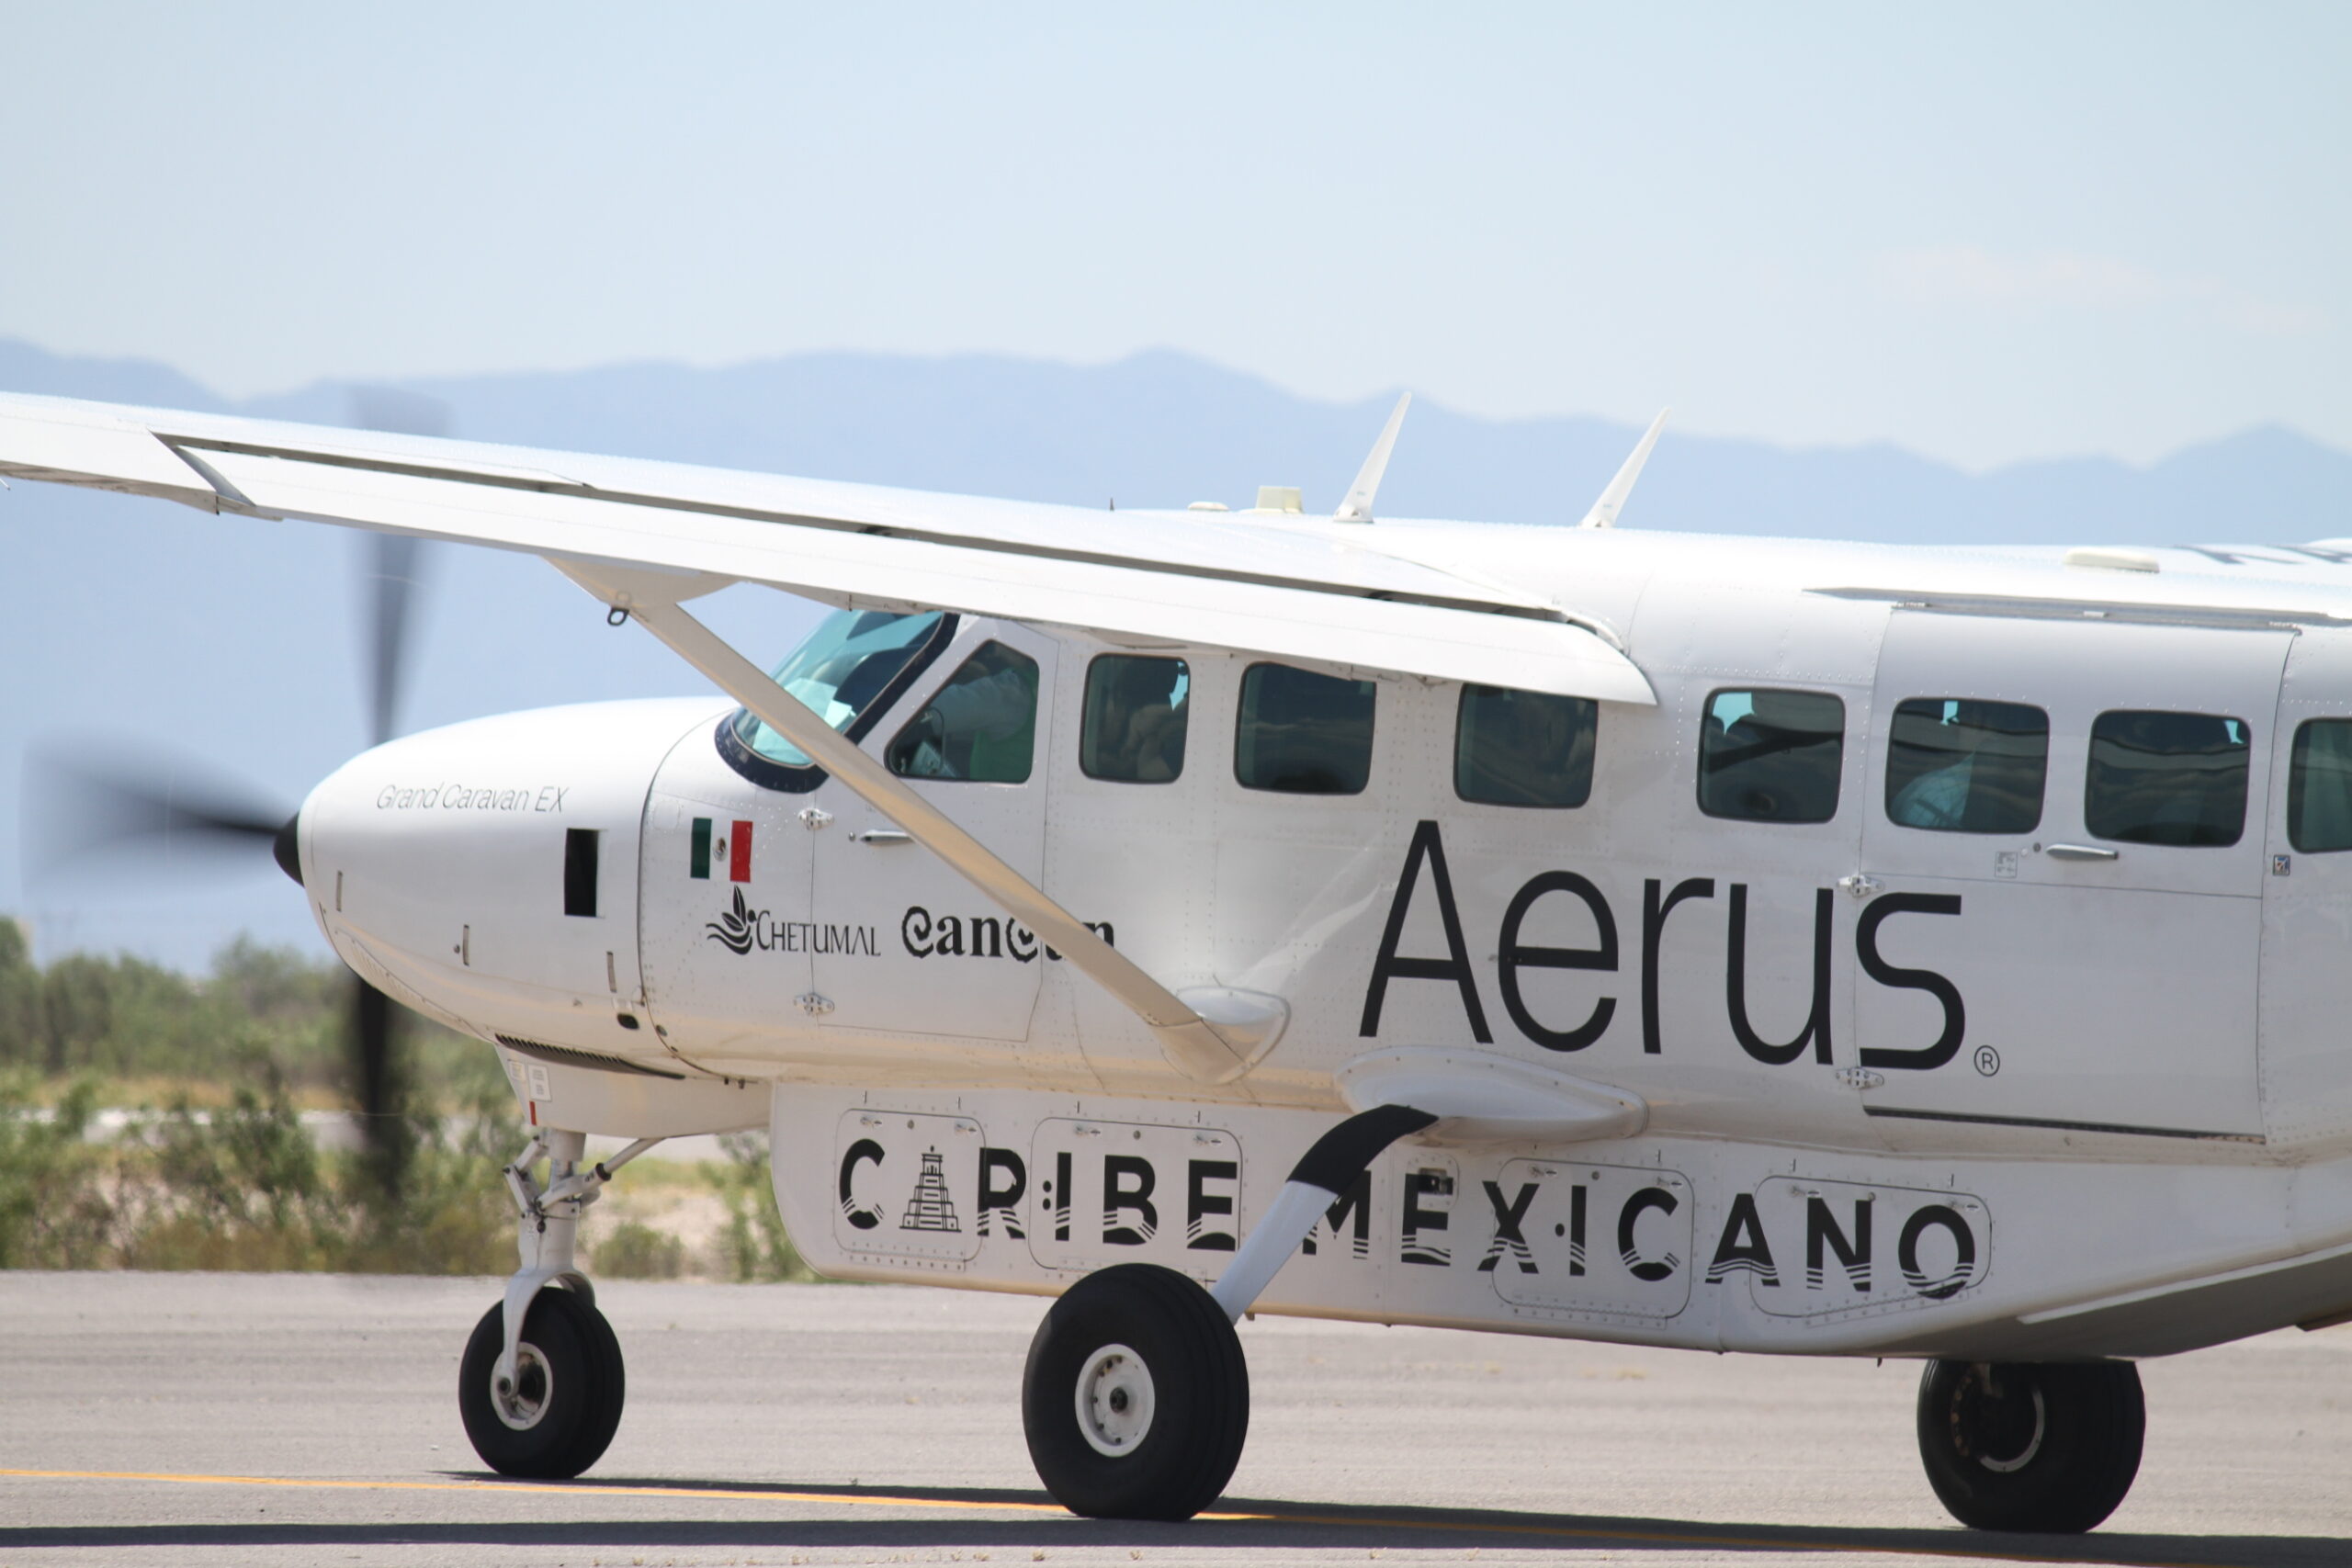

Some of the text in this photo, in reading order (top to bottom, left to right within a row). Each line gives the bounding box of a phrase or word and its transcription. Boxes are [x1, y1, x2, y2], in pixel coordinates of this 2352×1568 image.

[377, 782, 569, 813] Grand Caravan EX
[756, 909, 881, 956] CHETUMAL
[1359, 819, 1965, 1070] Aerus
